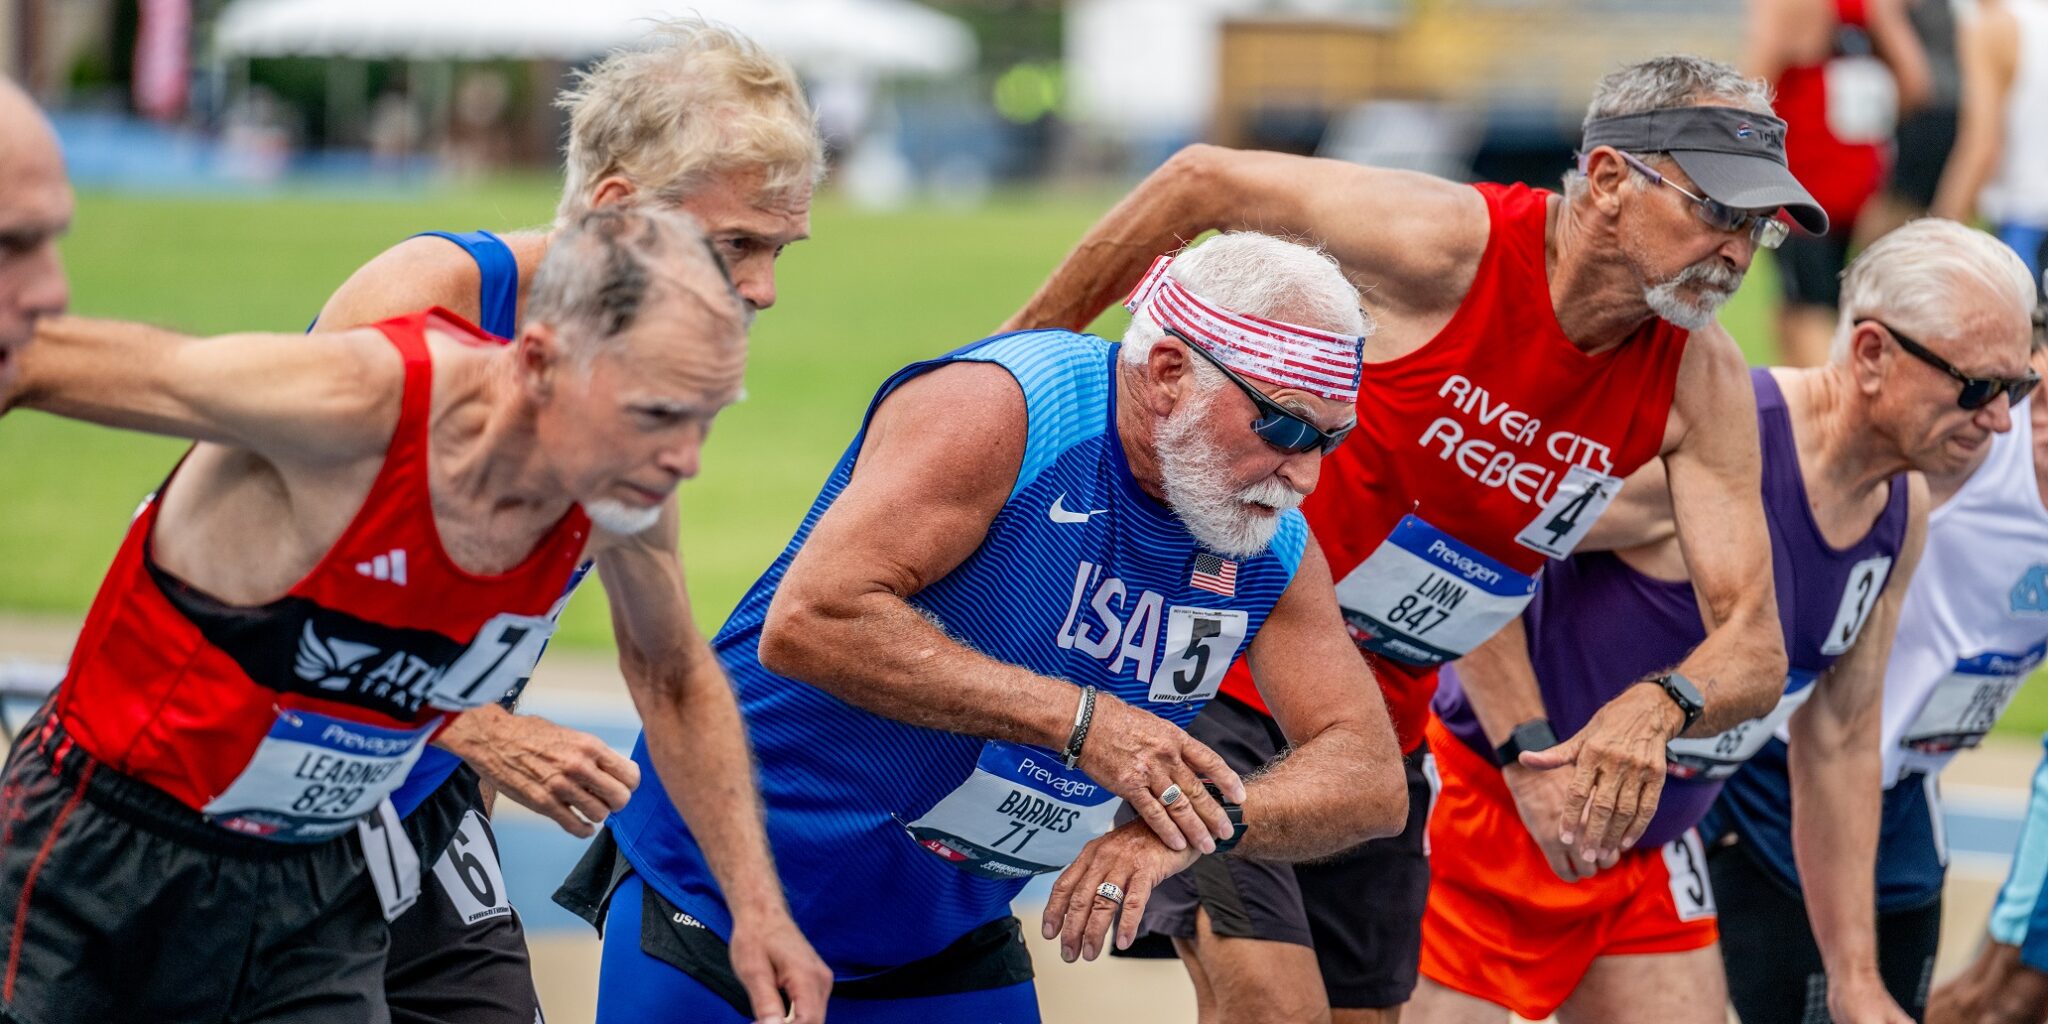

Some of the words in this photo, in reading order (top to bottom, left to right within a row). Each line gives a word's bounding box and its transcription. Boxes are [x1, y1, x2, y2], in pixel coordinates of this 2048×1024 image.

[1438, 374, 1541, 446] RIVER
[1546, 431, 1614, 479] CITY
[1545, 481, 1602, 546] 4
[1427, 539, 1500, 586] Prevagen
[1386, 594, 1451, 636] 847
[1416, 572, 1469, 611] LINN
[1842, 569, 1873, 643] 3
[1056, 560, 1164, 684] USA
[1172, 618, 1222, 695] 5
[291, 783, 365, 815] 829
[1017, 757, 1098, 798] Prevagen
[996, 789, 1081, 834] BARNES
[991, 820, 1040, 855] 71
[446, 828, 497, 908] 6
[1674, 837, 1705, 907] 3
[672, 912, 706, 929] USA
